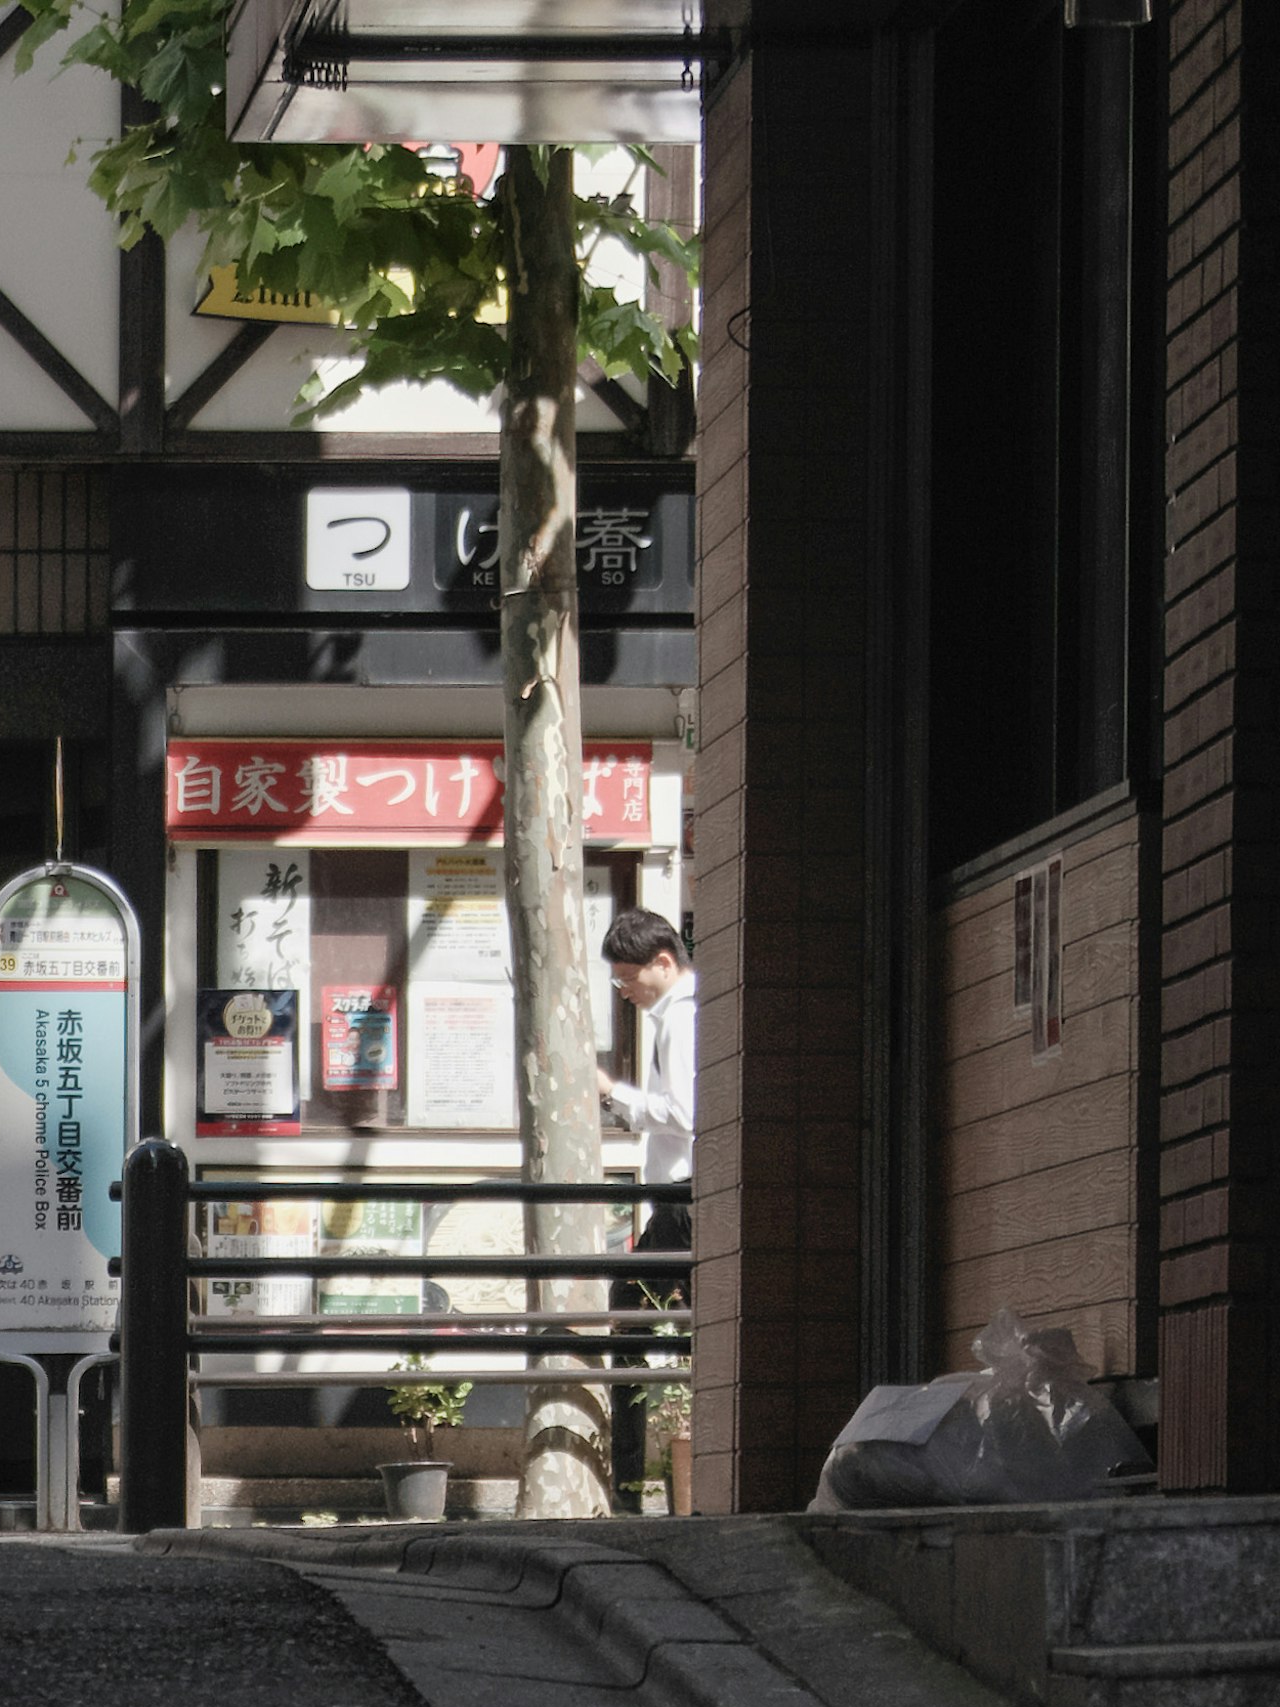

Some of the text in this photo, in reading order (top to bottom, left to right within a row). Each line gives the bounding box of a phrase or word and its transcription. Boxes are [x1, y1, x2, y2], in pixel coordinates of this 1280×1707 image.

[326, 516, 391, 560] つ
[343, 572, 625, 587] TSU KE SO
[175, 754, 644, 822] 自家製つけば 専門店
[0, 957, 16, 971] 39
[23, 961, 120, 977] 赤坂五丁目交番前
[35, 1009, 50, 1231] Akasaka 5 chome Police Box
[56, 1009, 83, 1231] 赤坂五丁目交番前
[19, 1279, 36, 1290] 40
[19, 1295, 36, 1306] 40
[38, 1296, 80, 1306] Akasaka
[82, 1295, 119, 1307] Station
